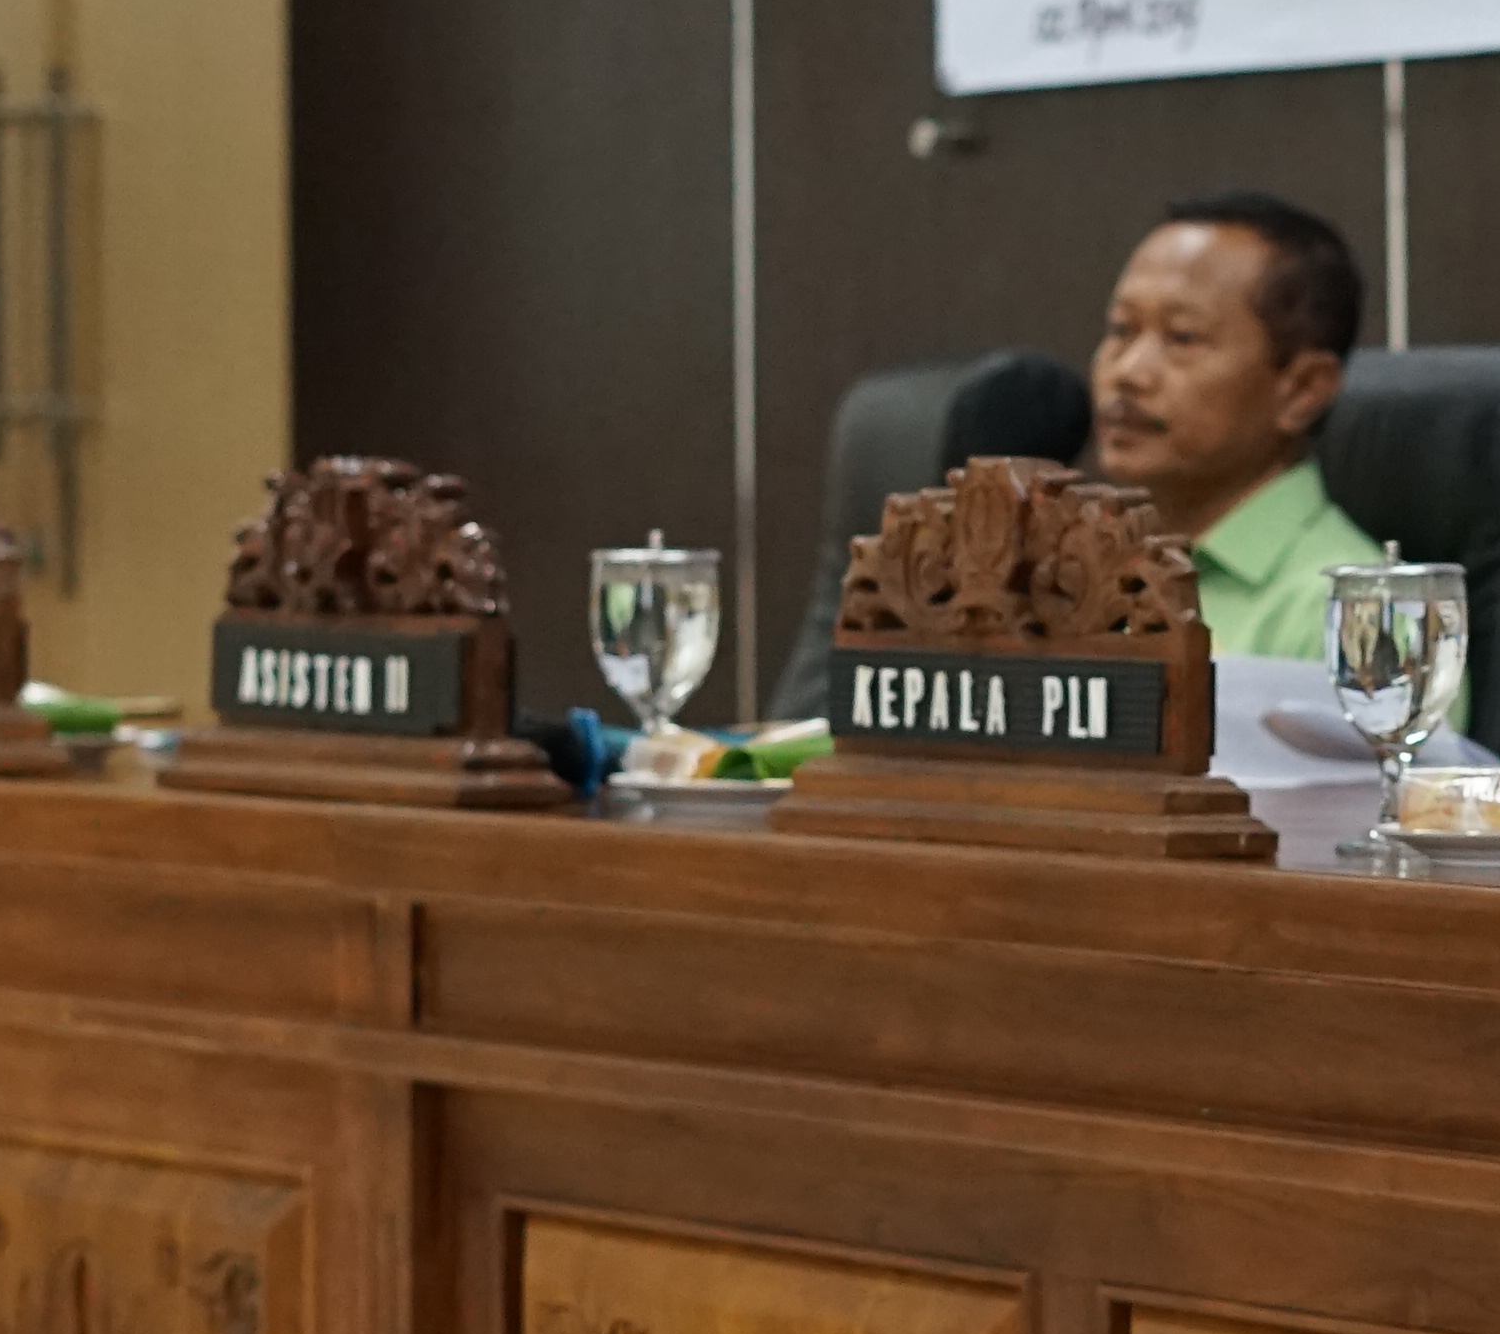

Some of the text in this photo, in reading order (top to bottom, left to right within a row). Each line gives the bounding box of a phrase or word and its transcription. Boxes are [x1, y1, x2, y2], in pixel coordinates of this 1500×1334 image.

[237, 645, 373, 716] ASISTEN
[852, 664, 1108, 740] KEPALA PLN
